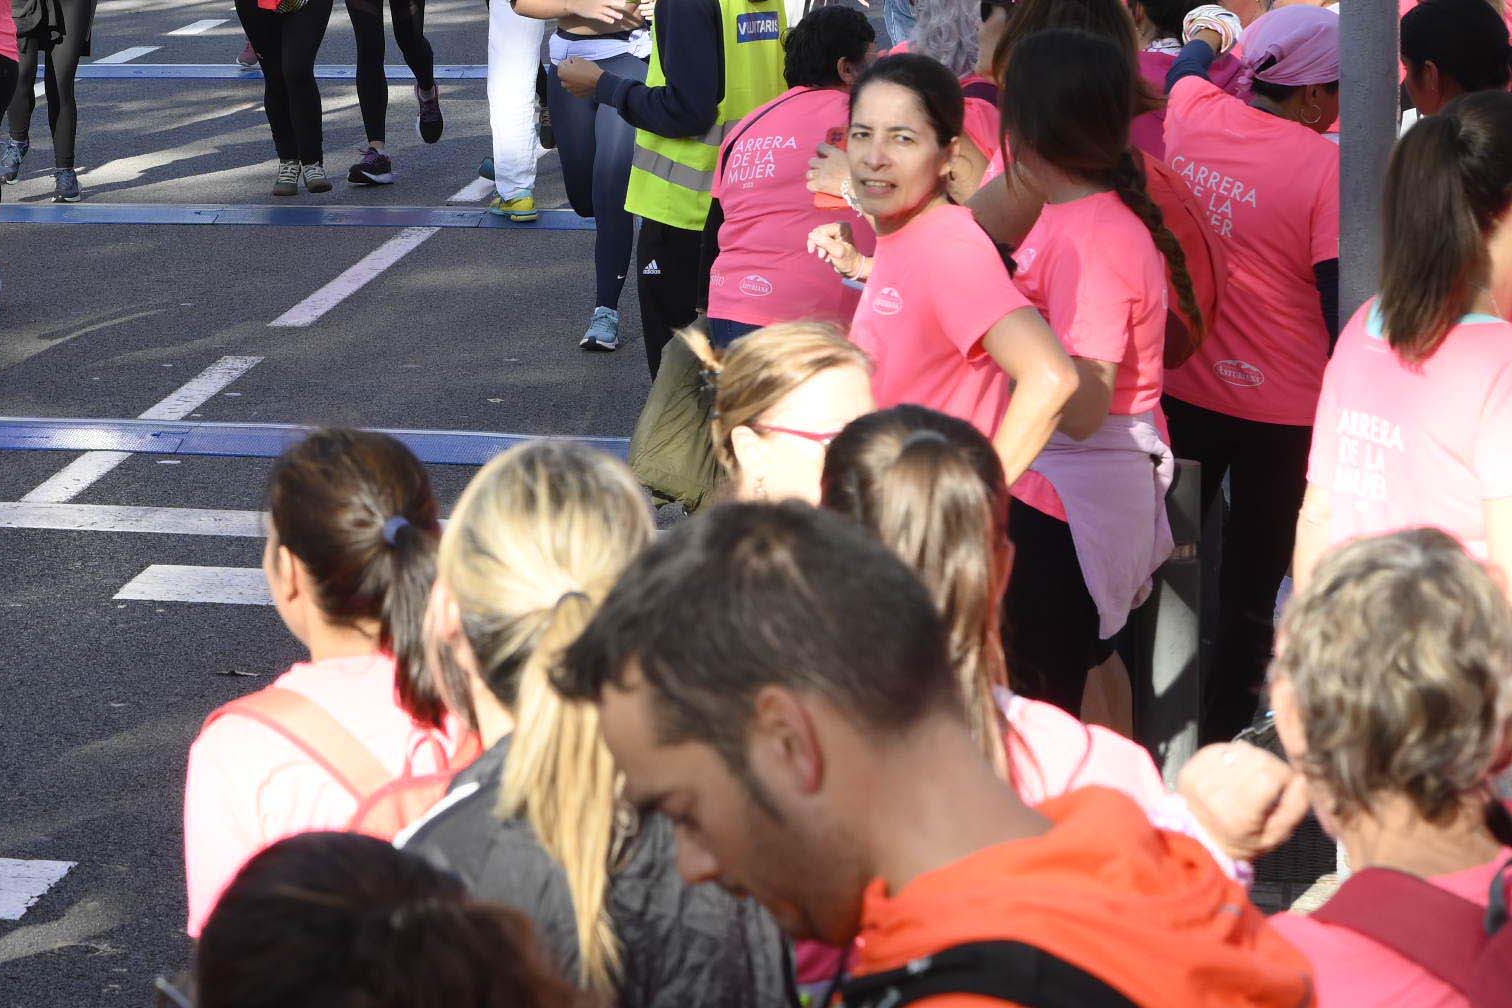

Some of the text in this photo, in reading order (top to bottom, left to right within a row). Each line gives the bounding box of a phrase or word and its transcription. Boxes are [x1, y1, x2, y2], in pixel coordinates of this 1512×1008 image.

[732, 150, 774, 168] DE LA
[728, 164, 775, 184] MUJER
[1172, 156, 1256, 208] CARRERA
[1209, 191, 1232, 218] LA
